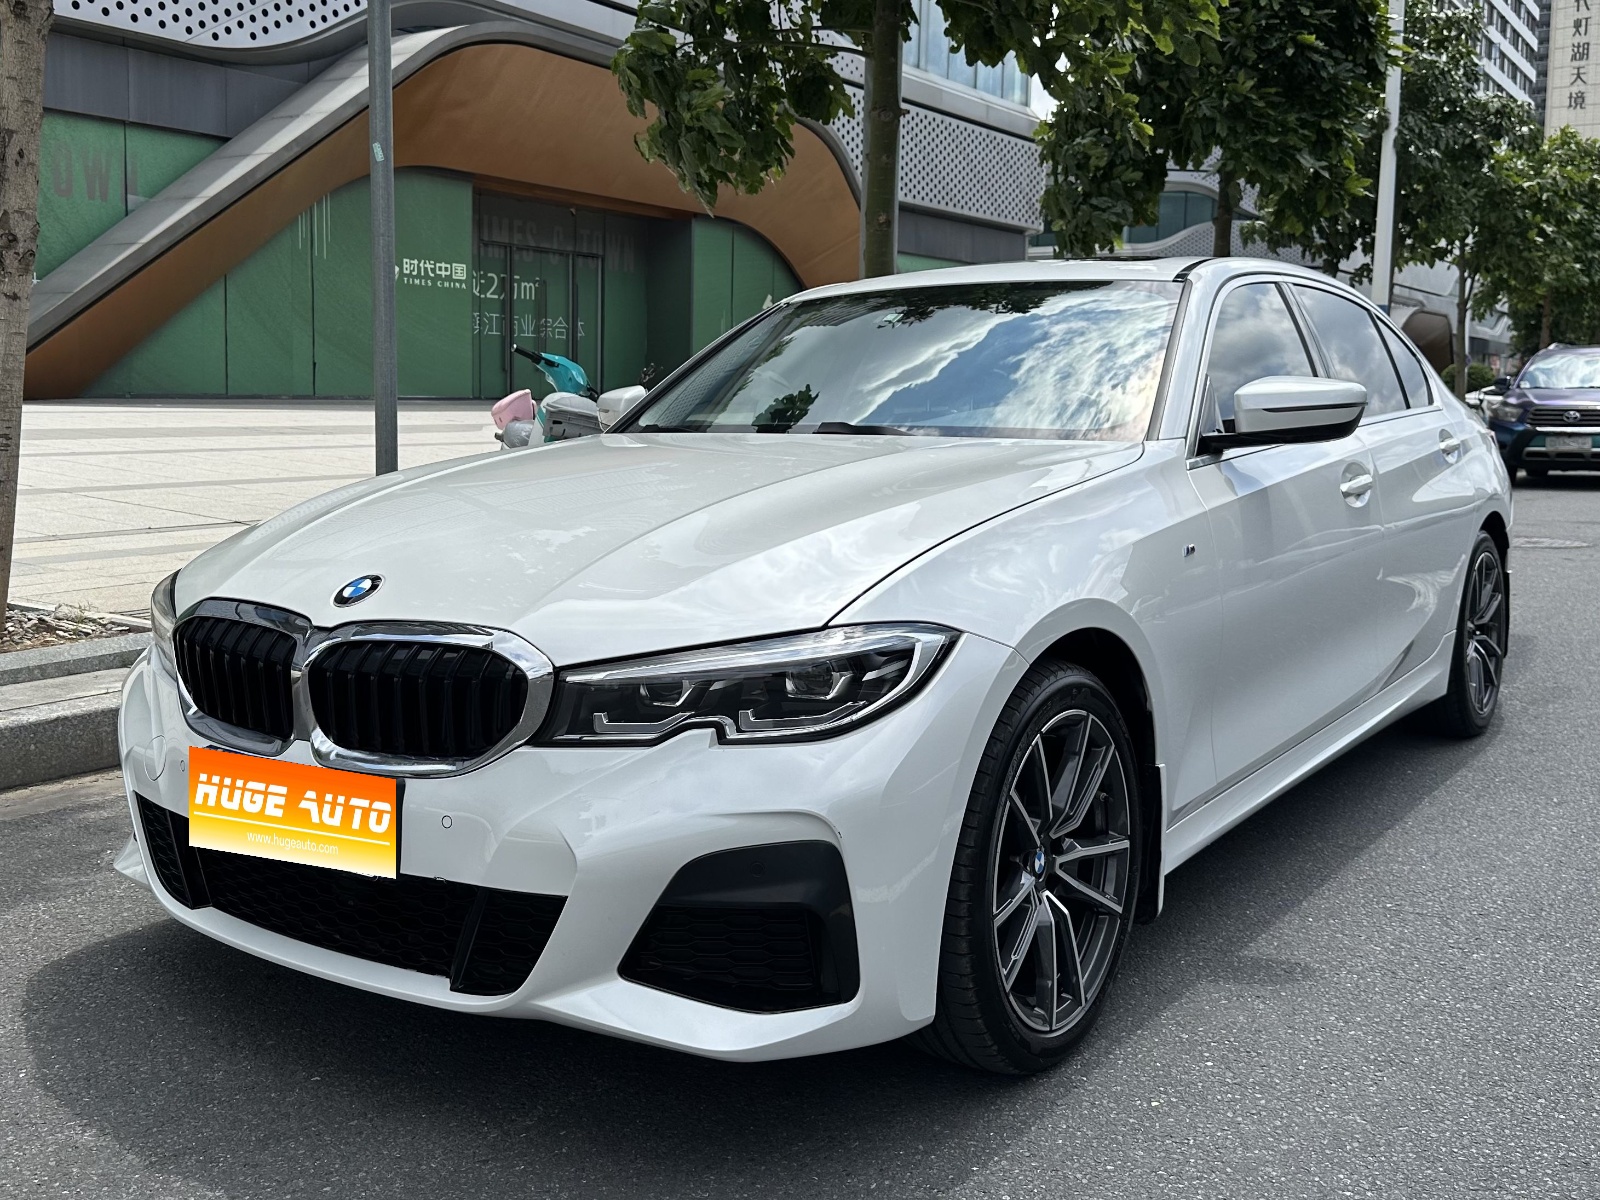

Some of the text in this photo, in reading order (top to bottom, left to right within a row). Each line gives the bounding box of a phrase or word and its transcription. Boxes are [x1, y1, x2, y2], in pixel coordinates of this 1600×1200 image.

[403, 258, 467, 280] 时代中国
[403, 277, 467, 290] TIMES CHINA
